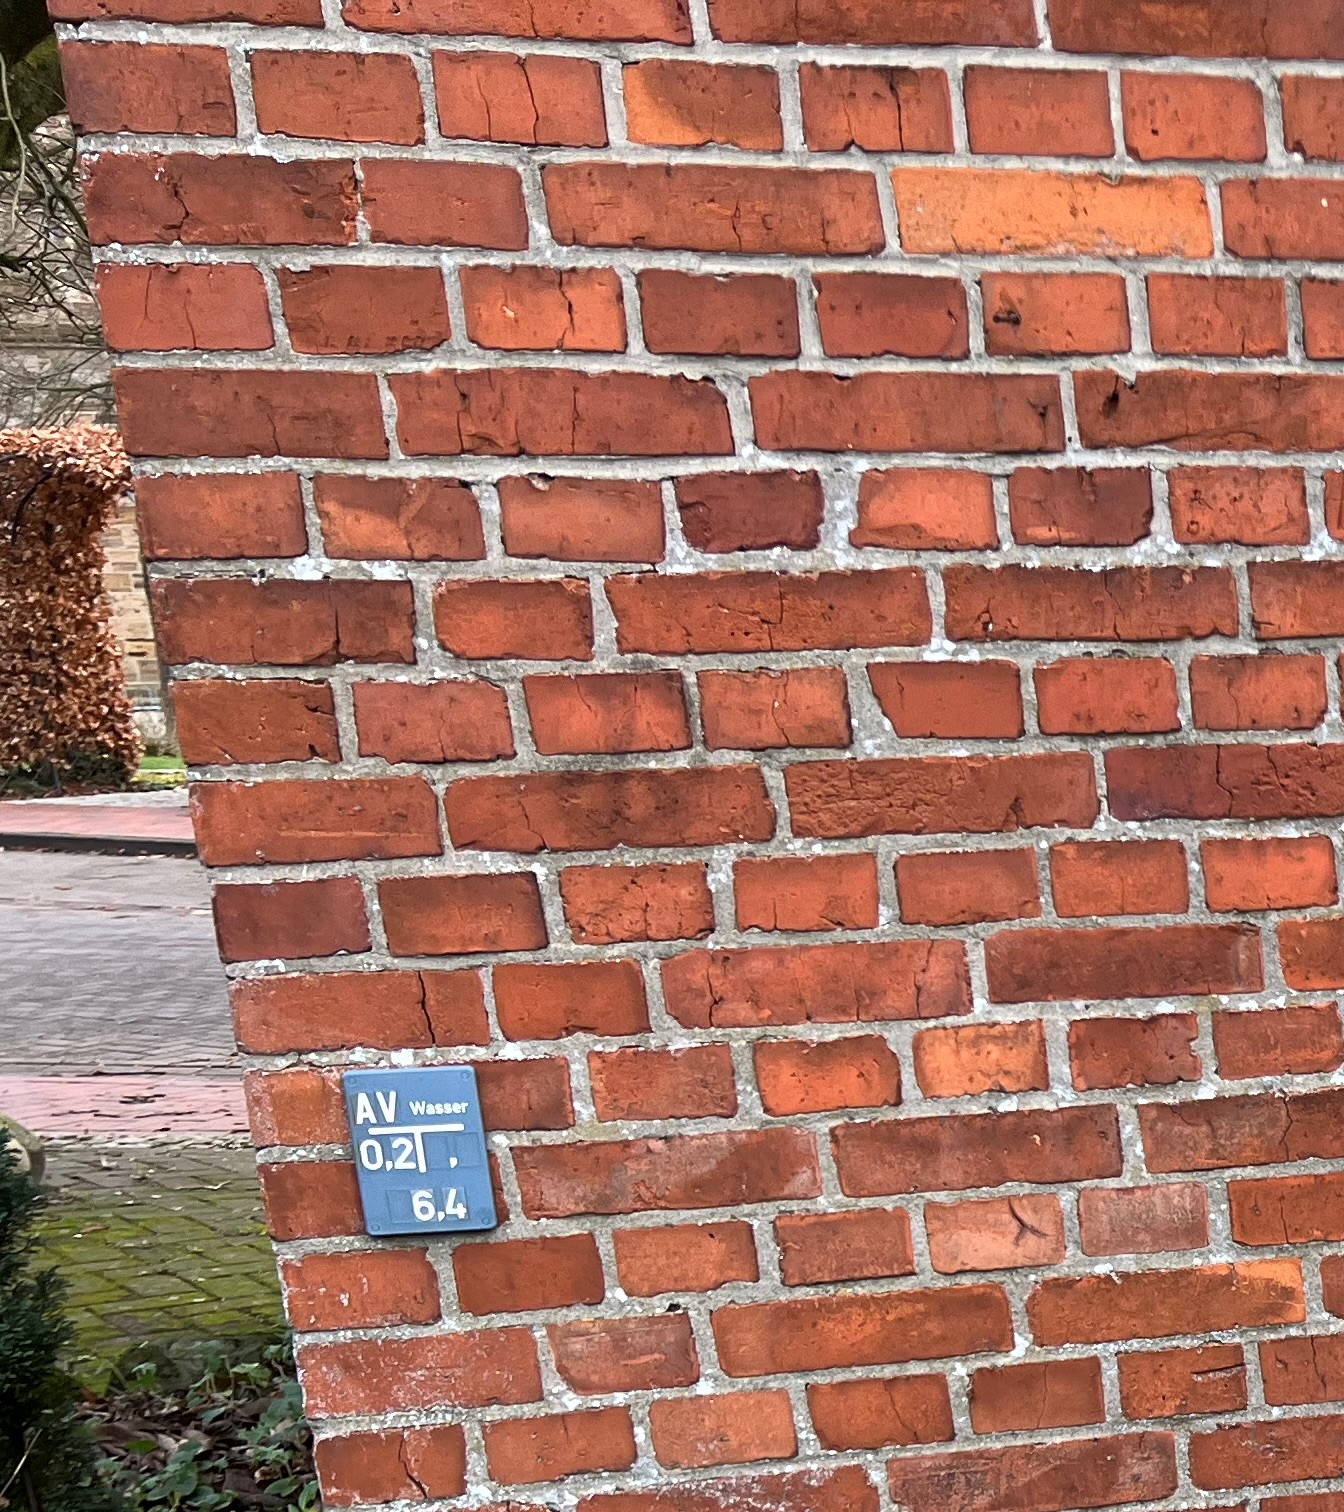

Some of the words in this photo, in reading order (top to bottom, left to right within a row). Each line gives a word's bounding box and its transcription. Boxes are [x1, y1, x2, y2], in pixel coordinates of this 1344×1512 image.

[356, 1091, 397, 1124] AV
[409, 1101, 469, 1116] Wasser
[412, 1188, 467, 1221] 6,4
